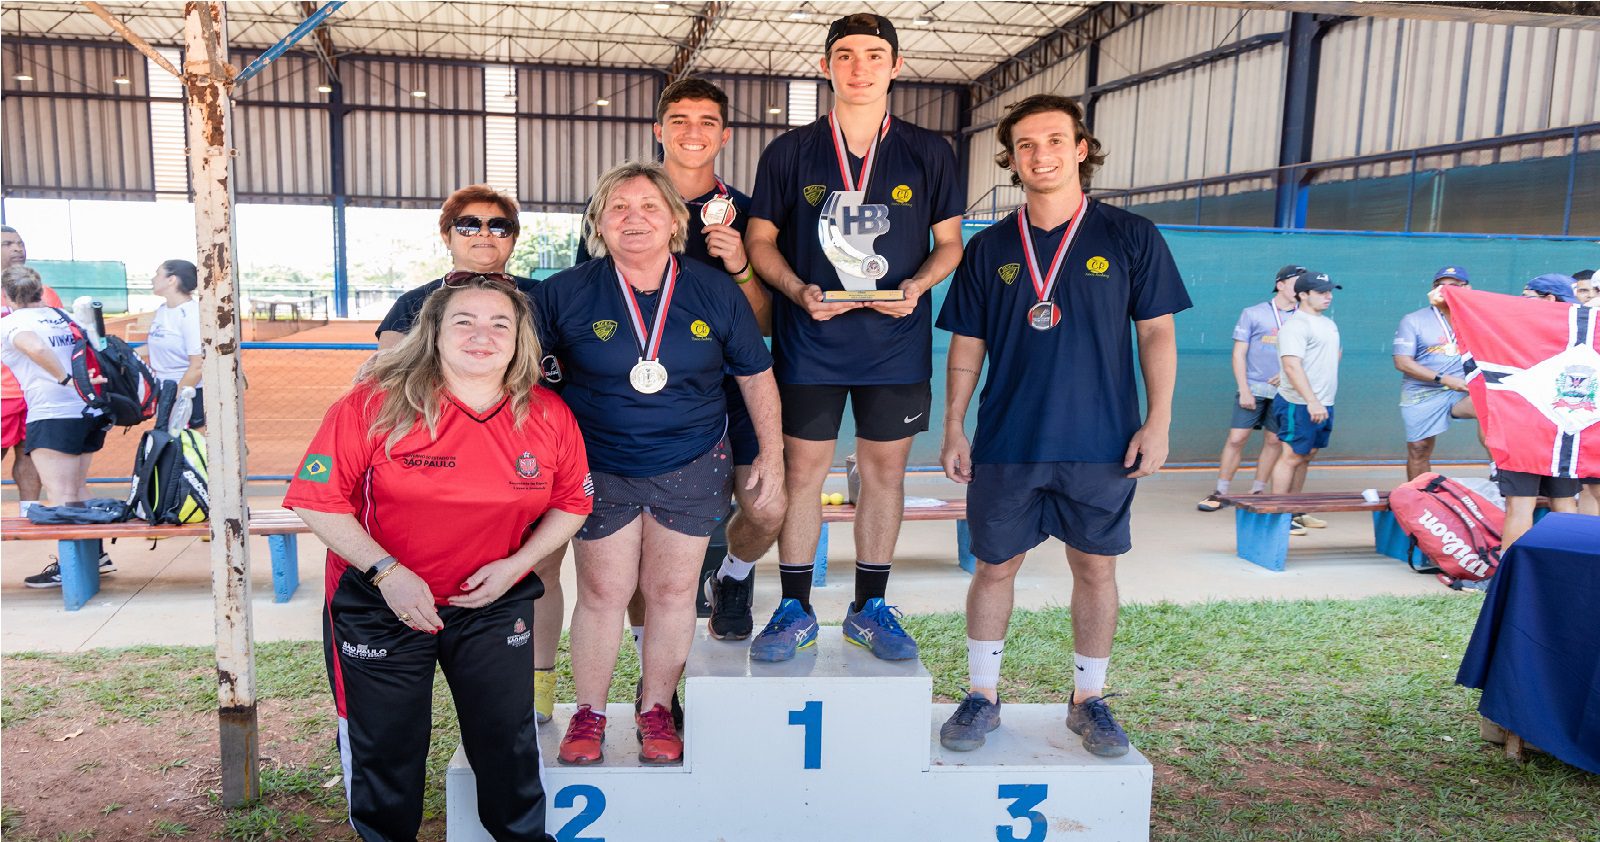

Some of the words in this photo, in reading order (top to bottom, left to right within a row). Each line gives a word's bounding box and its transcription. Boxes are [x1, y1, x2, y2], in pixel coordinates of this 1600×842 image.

[424, 460, 456, 468] PAULO
[1418, 508, 1490, 578] Wilson
[788, 701, 822, 769] 1
[554, 784, 606, 842] 2
[996, 784, 1048, 842] 3
